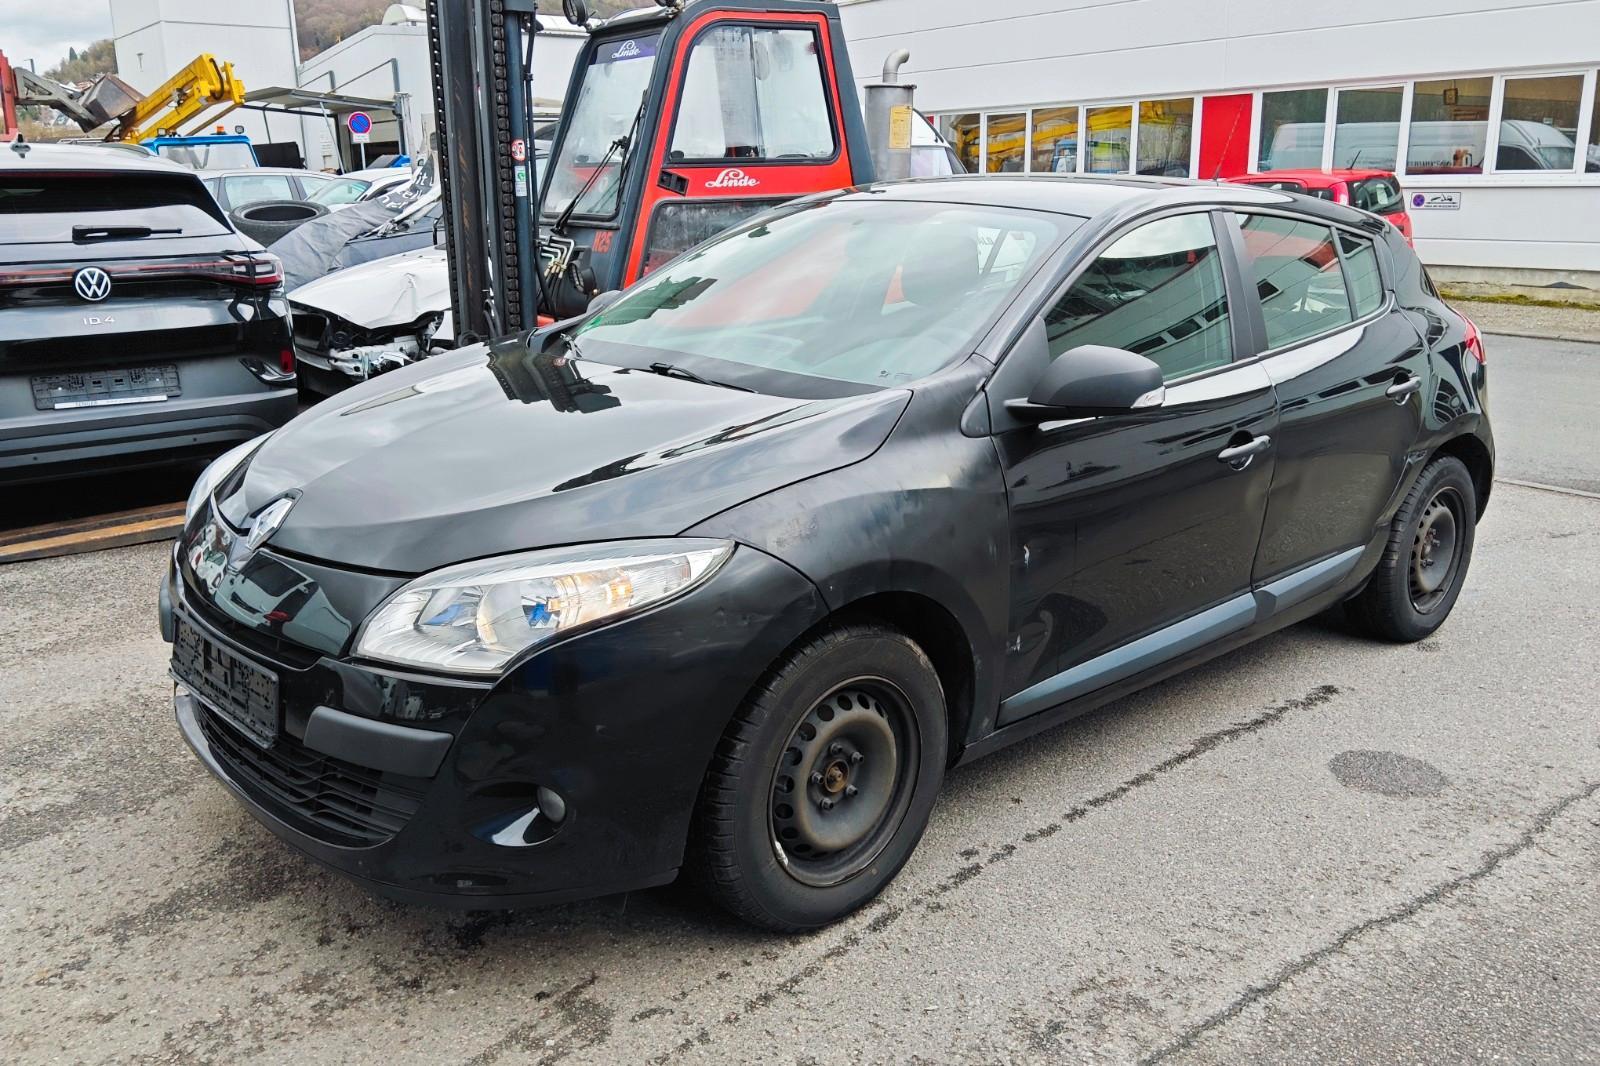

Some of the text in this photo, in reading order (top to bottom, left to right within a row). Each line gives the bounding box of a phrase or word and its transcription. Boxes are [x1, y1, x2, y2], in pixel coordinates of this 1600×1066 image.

[611, 40, 640, 59] Linde
[705, 168, 760, 188] Linde
[592, 231, 613, 253] H25
[75, 267, 111, 301] VW
